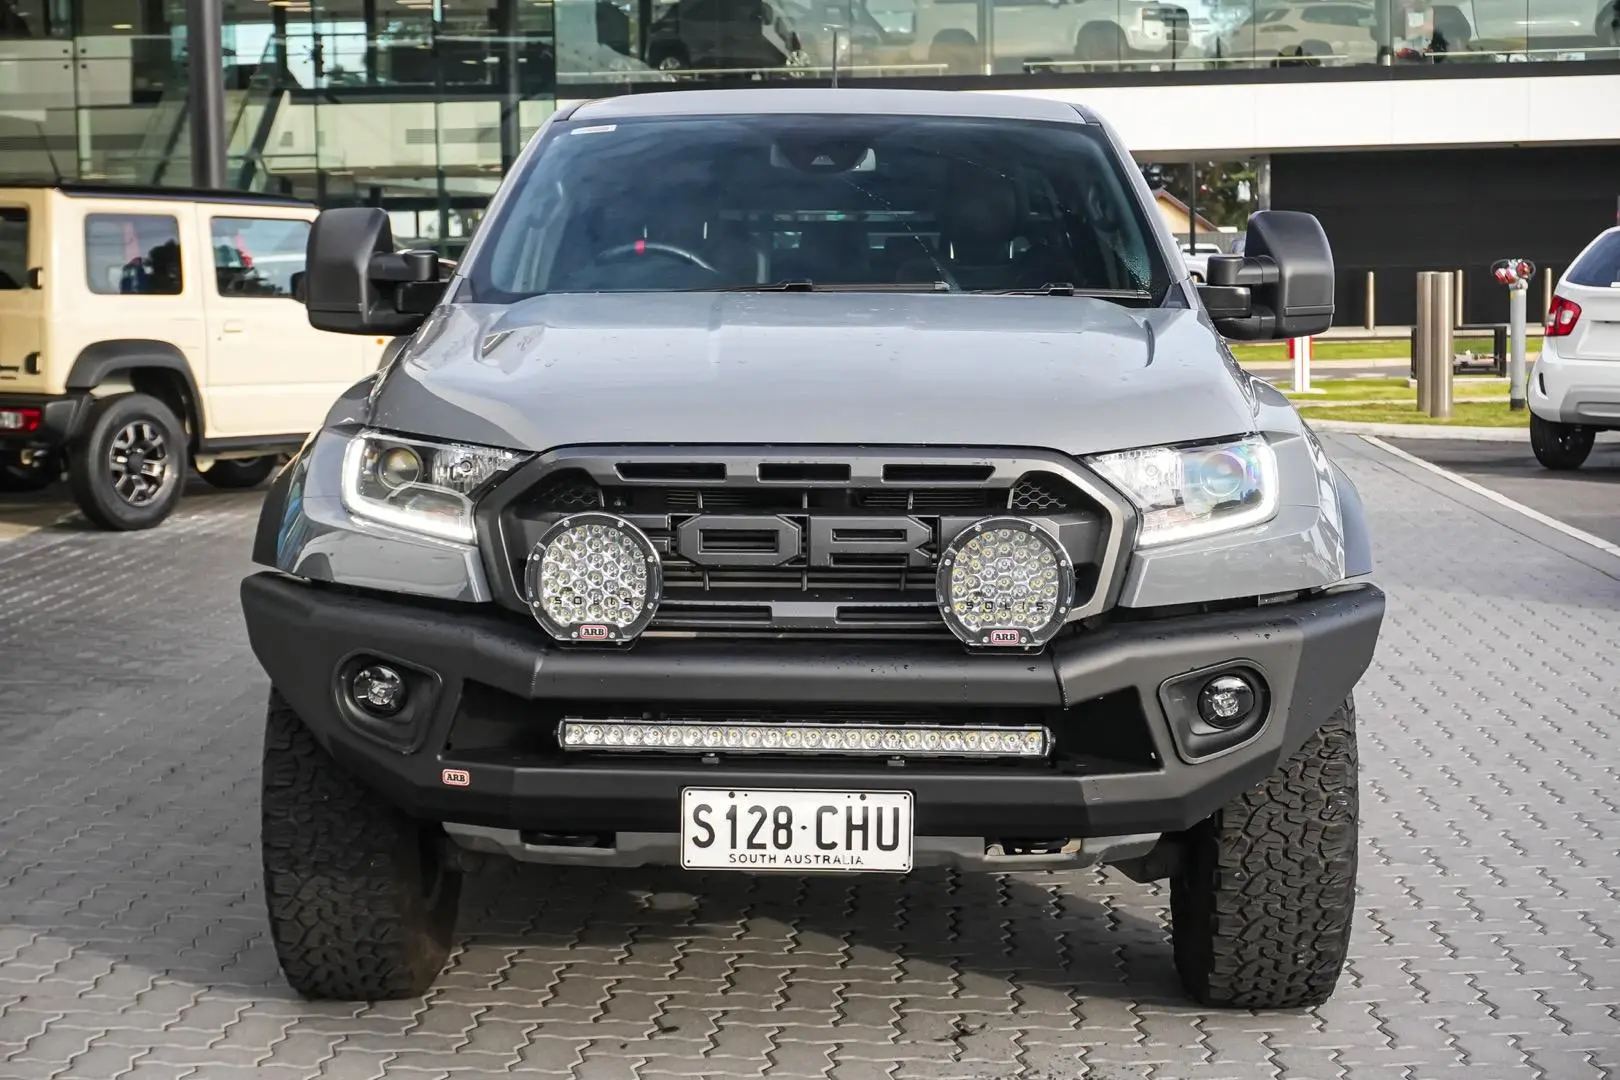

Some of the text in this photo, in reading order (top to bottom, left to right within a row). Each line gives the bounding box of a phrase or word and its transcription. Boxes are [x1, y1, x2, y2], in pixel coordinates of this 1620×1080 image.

[583, 628, 604, 636] ARB
[994, 633, 1016, 641] ARB
[446, 773, 466, 782] ARB
[729, 853, 864, 865] SOUTH AUSTRALIA
